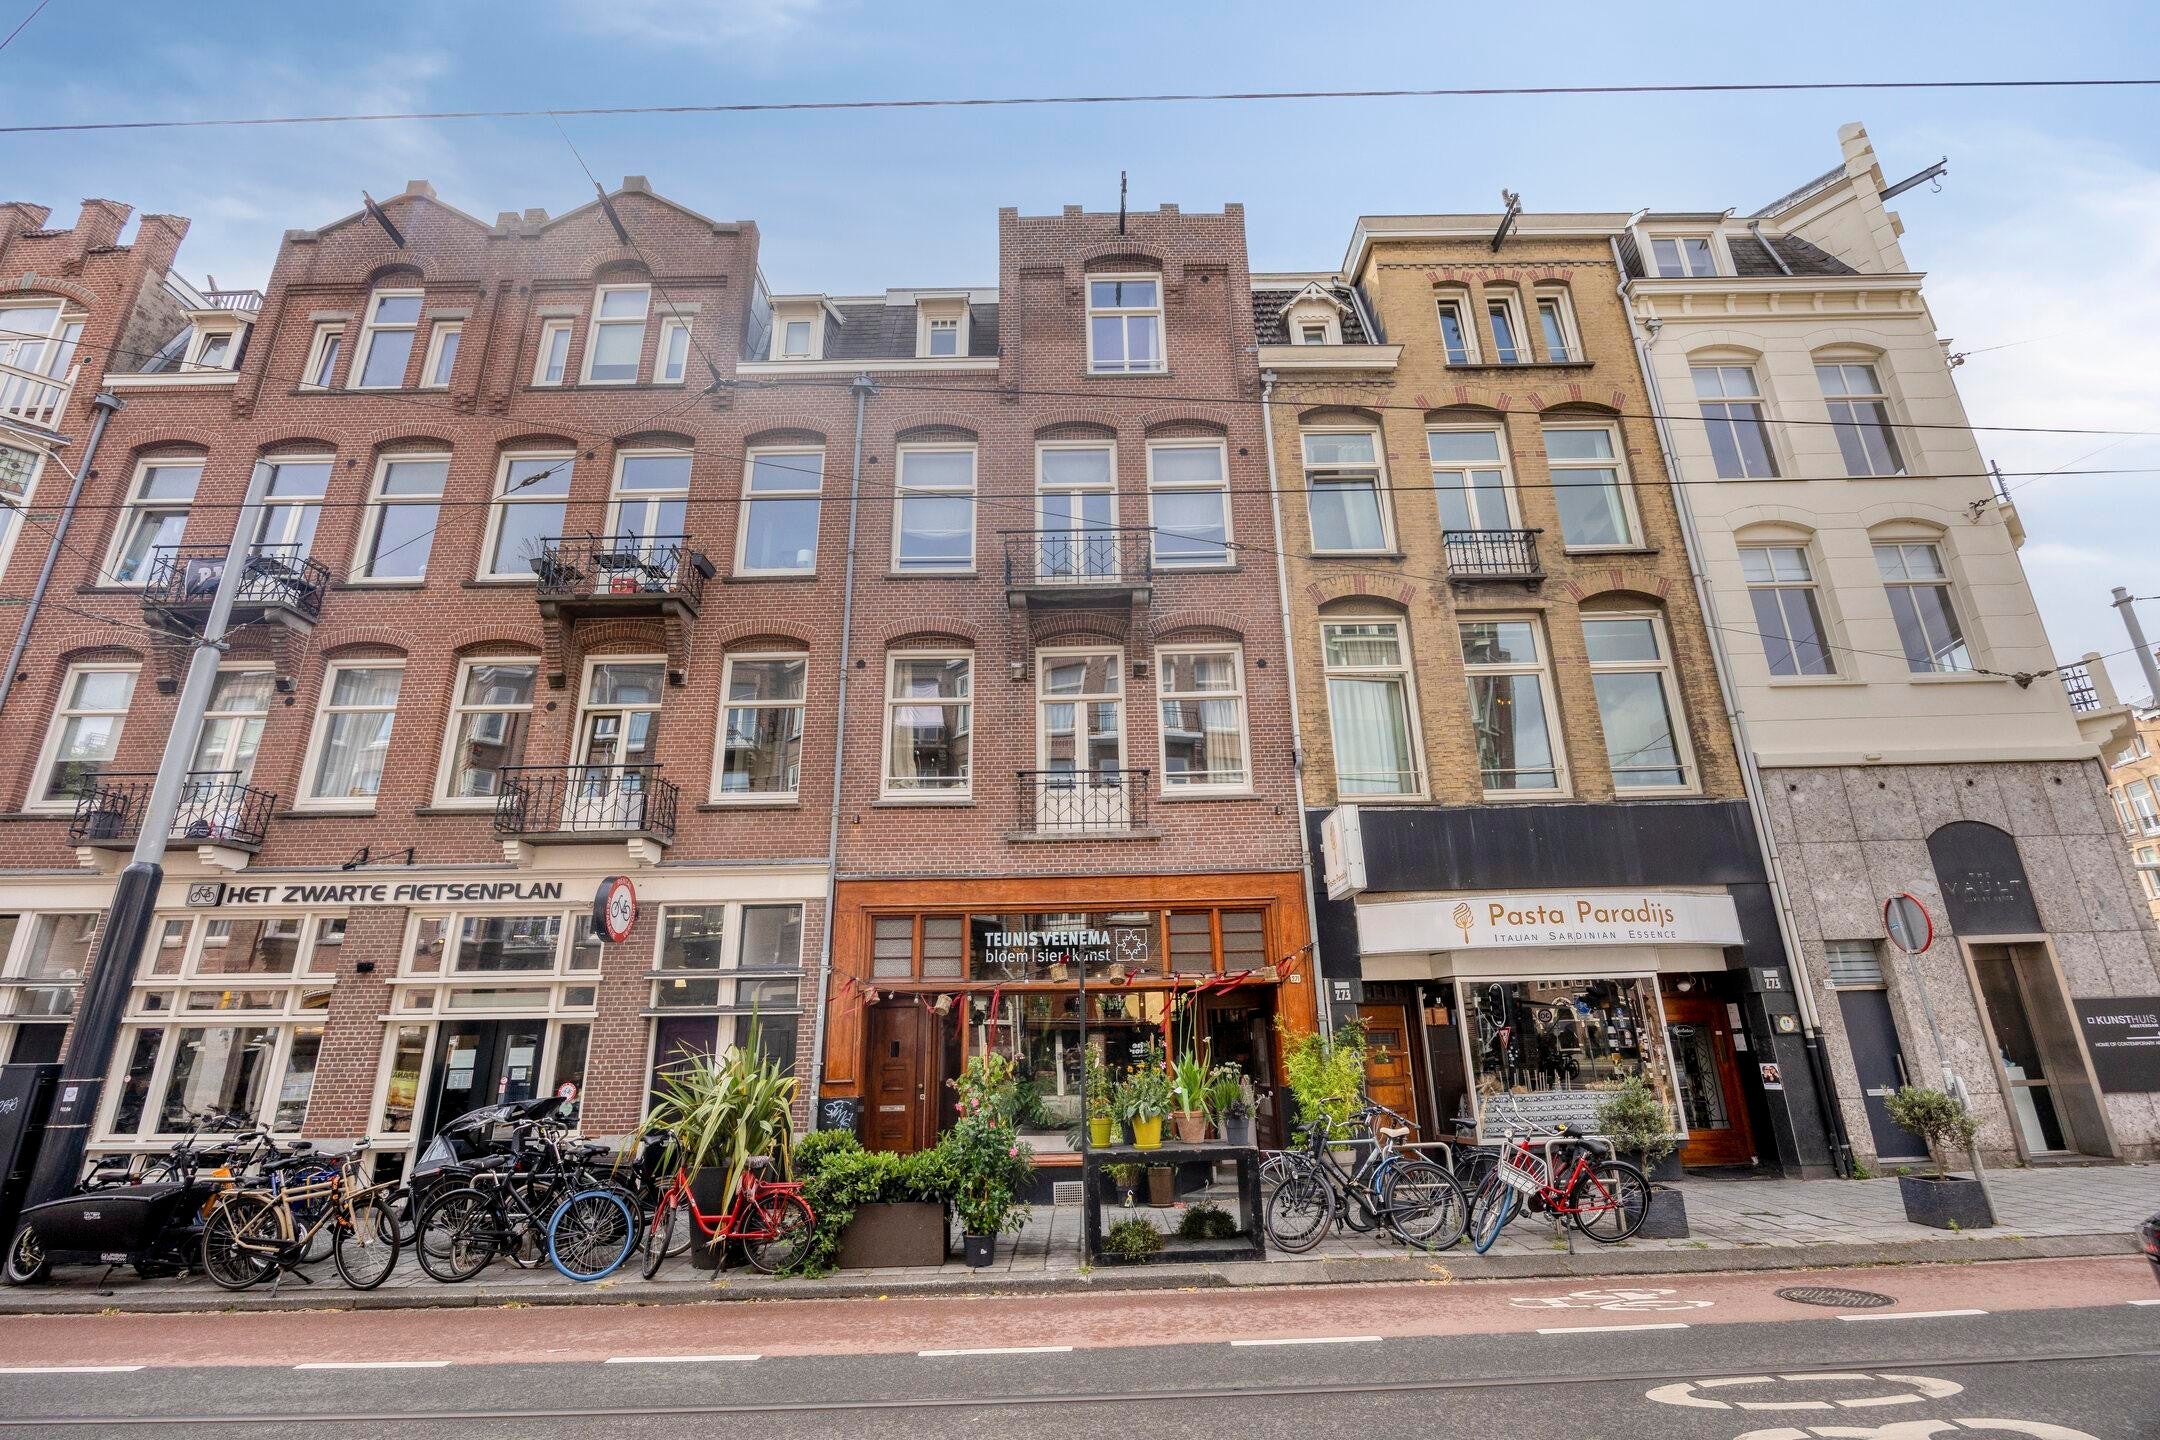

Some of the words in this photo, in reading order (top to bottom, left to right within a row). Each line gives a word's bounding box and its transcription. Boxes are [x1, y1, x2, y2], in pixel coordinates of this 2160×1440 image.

[226, 886, 277, 903] HET
[281, 884, 388, 903] ZWARTE
[393, 882, 563, 901] FIETSENPLAN
[1488, 902, 1565, 926] Pasta
[1577, 898, 1675, 928] Paradijs
[984, 931, 1039, 947] TEUNIS
[1040, 930, 1111, 946] VEENEMA
[985, 949, 1028, 963] bloem
[1037, 949, 1062, 962] sier
[1764, 978, 1781, 990] 273
[1334, 989, 1352, 1001] 273
[2095, 1014, 2158, 1025] KUNSTHUIS
